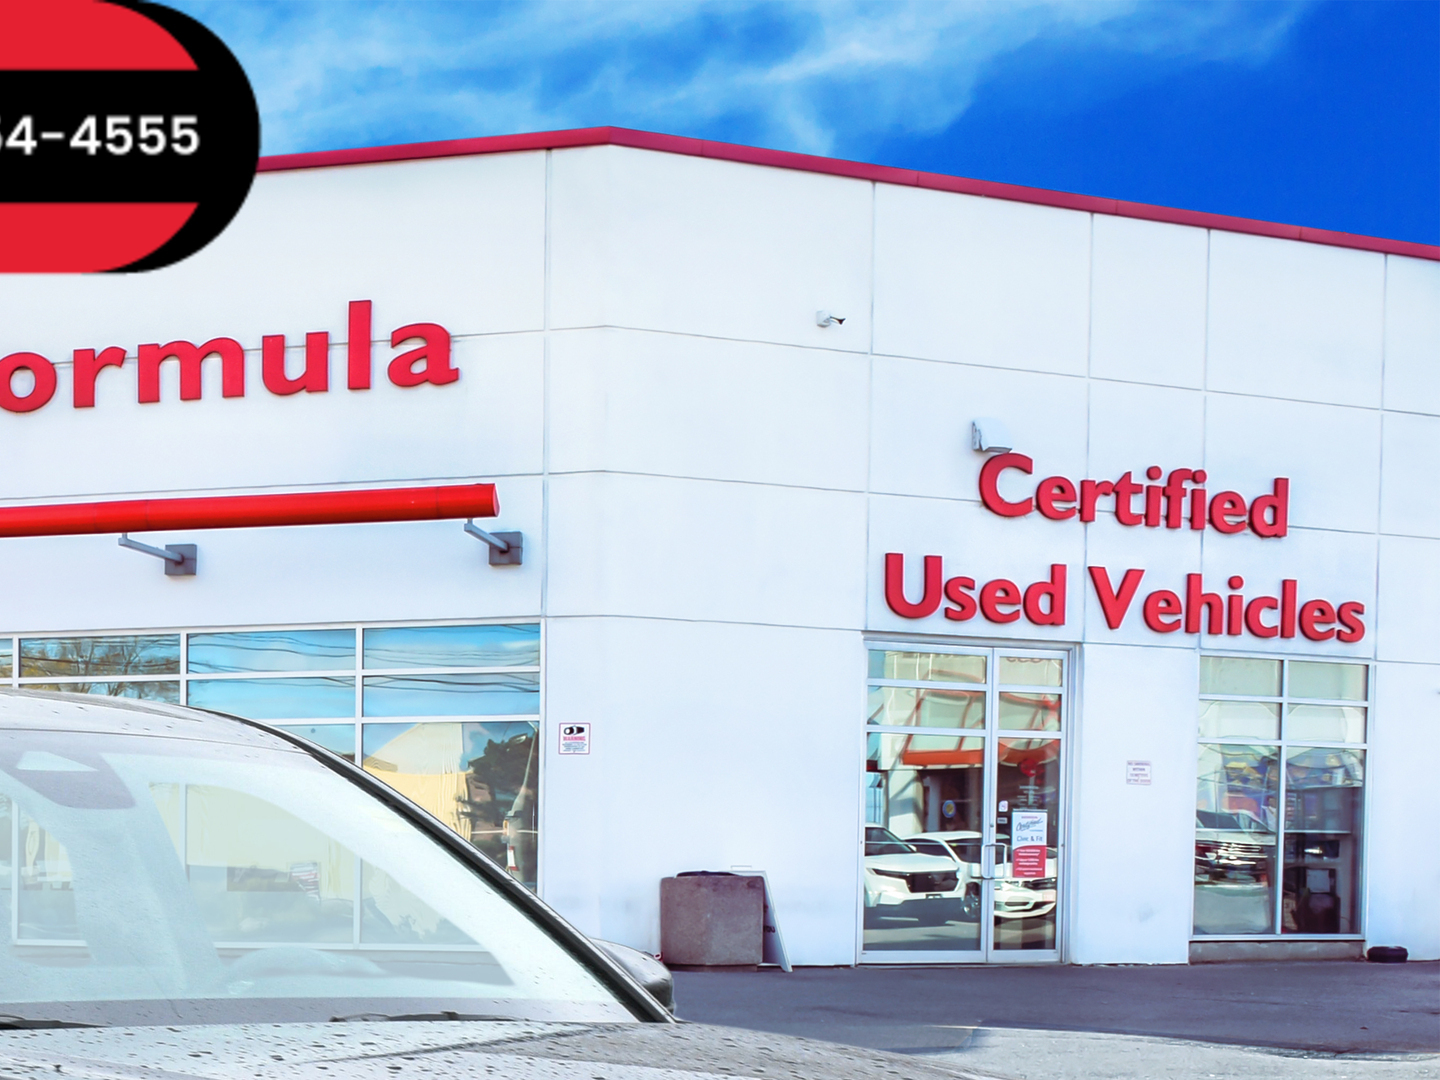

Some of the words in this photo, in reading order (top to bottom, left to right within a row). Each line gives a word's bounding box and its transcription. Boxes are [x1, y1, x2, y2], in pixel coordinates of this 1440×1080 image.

[979, 453, 1289, 538] Certified
[885, 552, 1067, 626] Used
[1088, 566, 1366, 643] Vehicles
